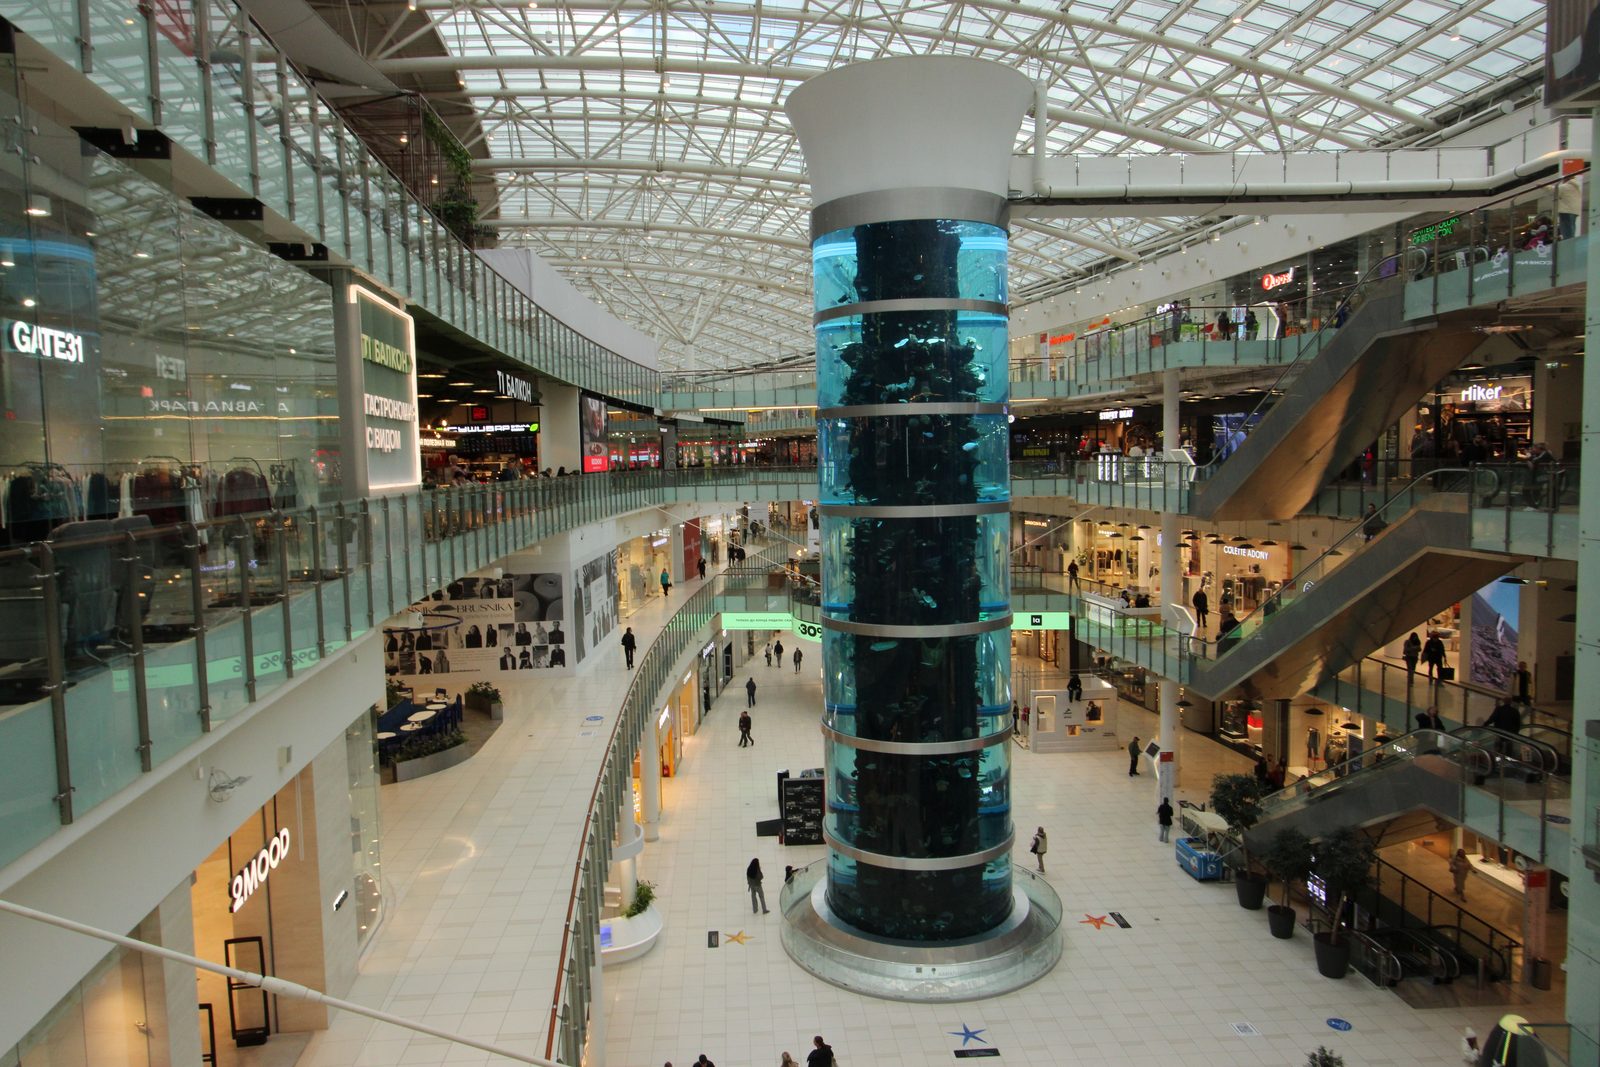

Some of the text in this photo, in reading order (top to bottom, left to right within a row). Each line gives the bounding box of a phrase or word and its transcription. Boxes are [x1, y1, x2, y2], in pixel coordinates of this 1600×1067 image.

[13, 320, 84, 363] GATE31
[505, 374, 532, 403] БАЛКОН
[1461, 384, 1503, 402] Hiker
[374, 428, 401, 453] ВИДОМ
[232, 827, 290, 914] 2MOOD
